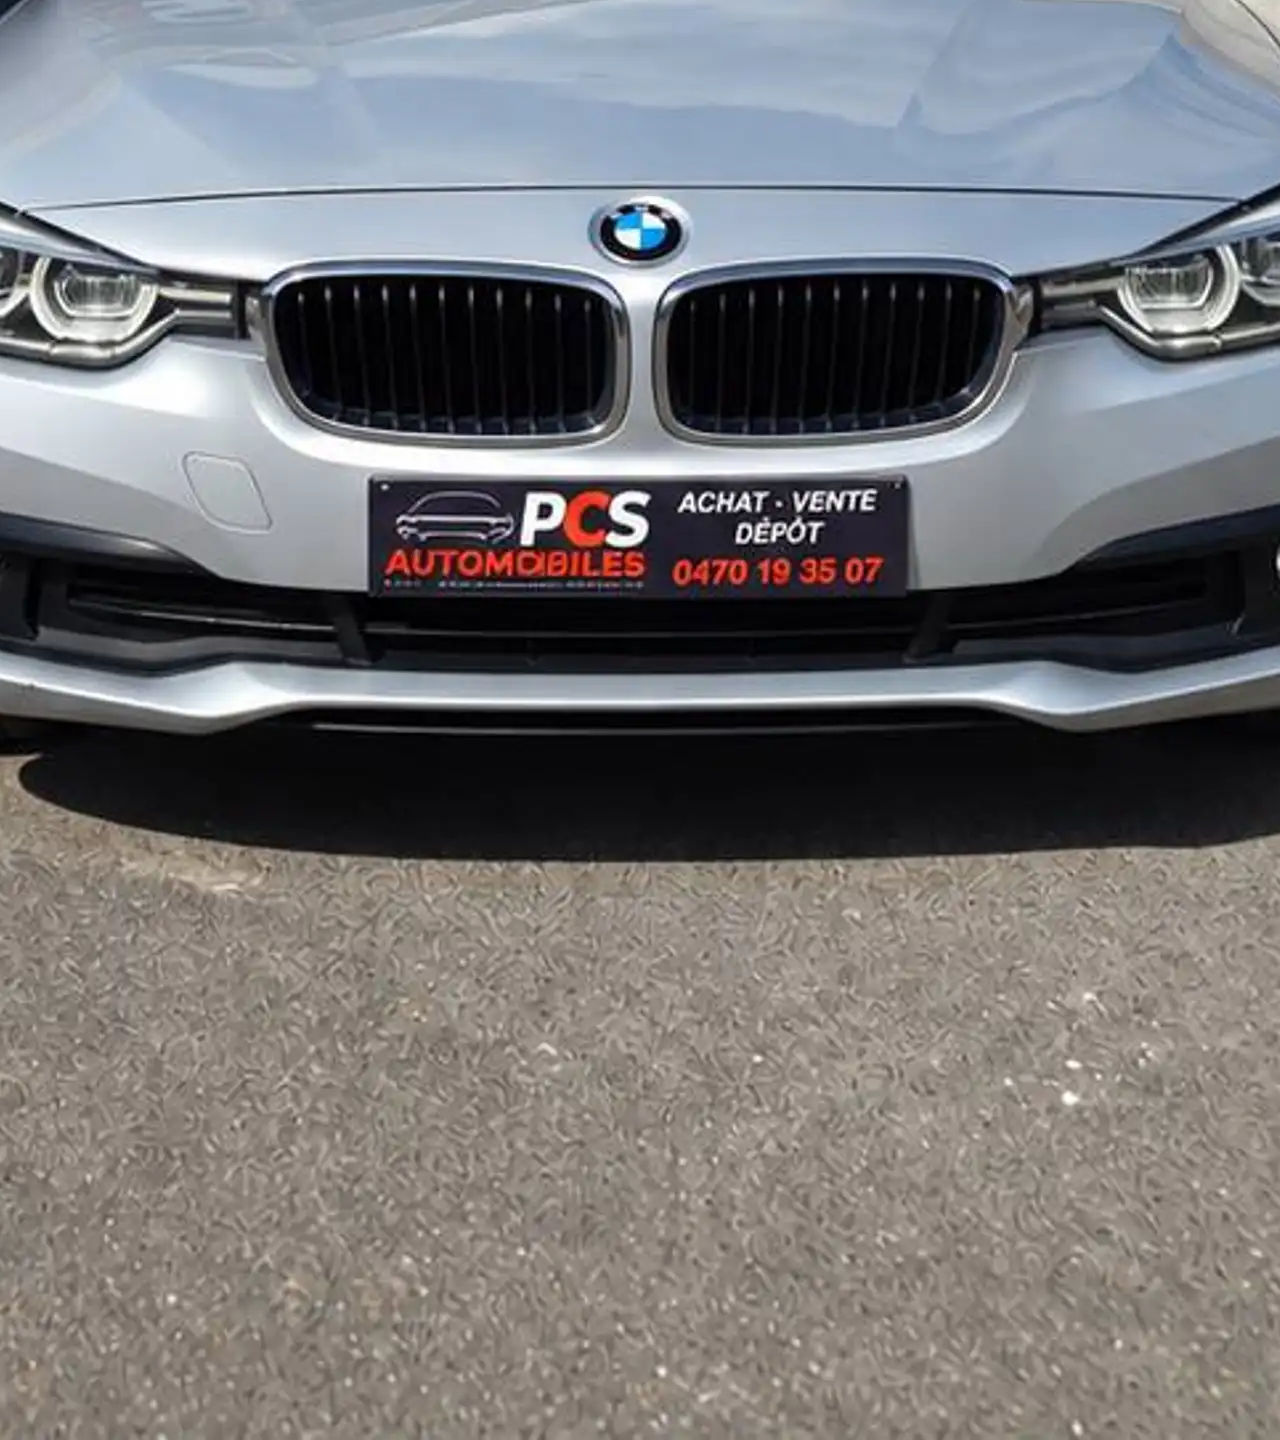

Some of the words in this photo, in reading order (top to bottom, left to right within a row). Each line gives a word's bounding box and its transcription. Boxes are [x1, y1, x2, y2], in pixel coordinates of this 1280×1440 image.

[677, 491, 769, 513] ACHAT
[793, 489, 878, 511] VENTE
[520, 490, 651, 548] PCS
[735, 517, 825, 544] DÉPÔT
[385, 549, 645, 577] AUTOMOBILES
[672, 559, 748, 585] 0470
[757, 559, 791, 585] 19
[800, 558, 838, 584] 35
[845, 558, 884, 584] 07
